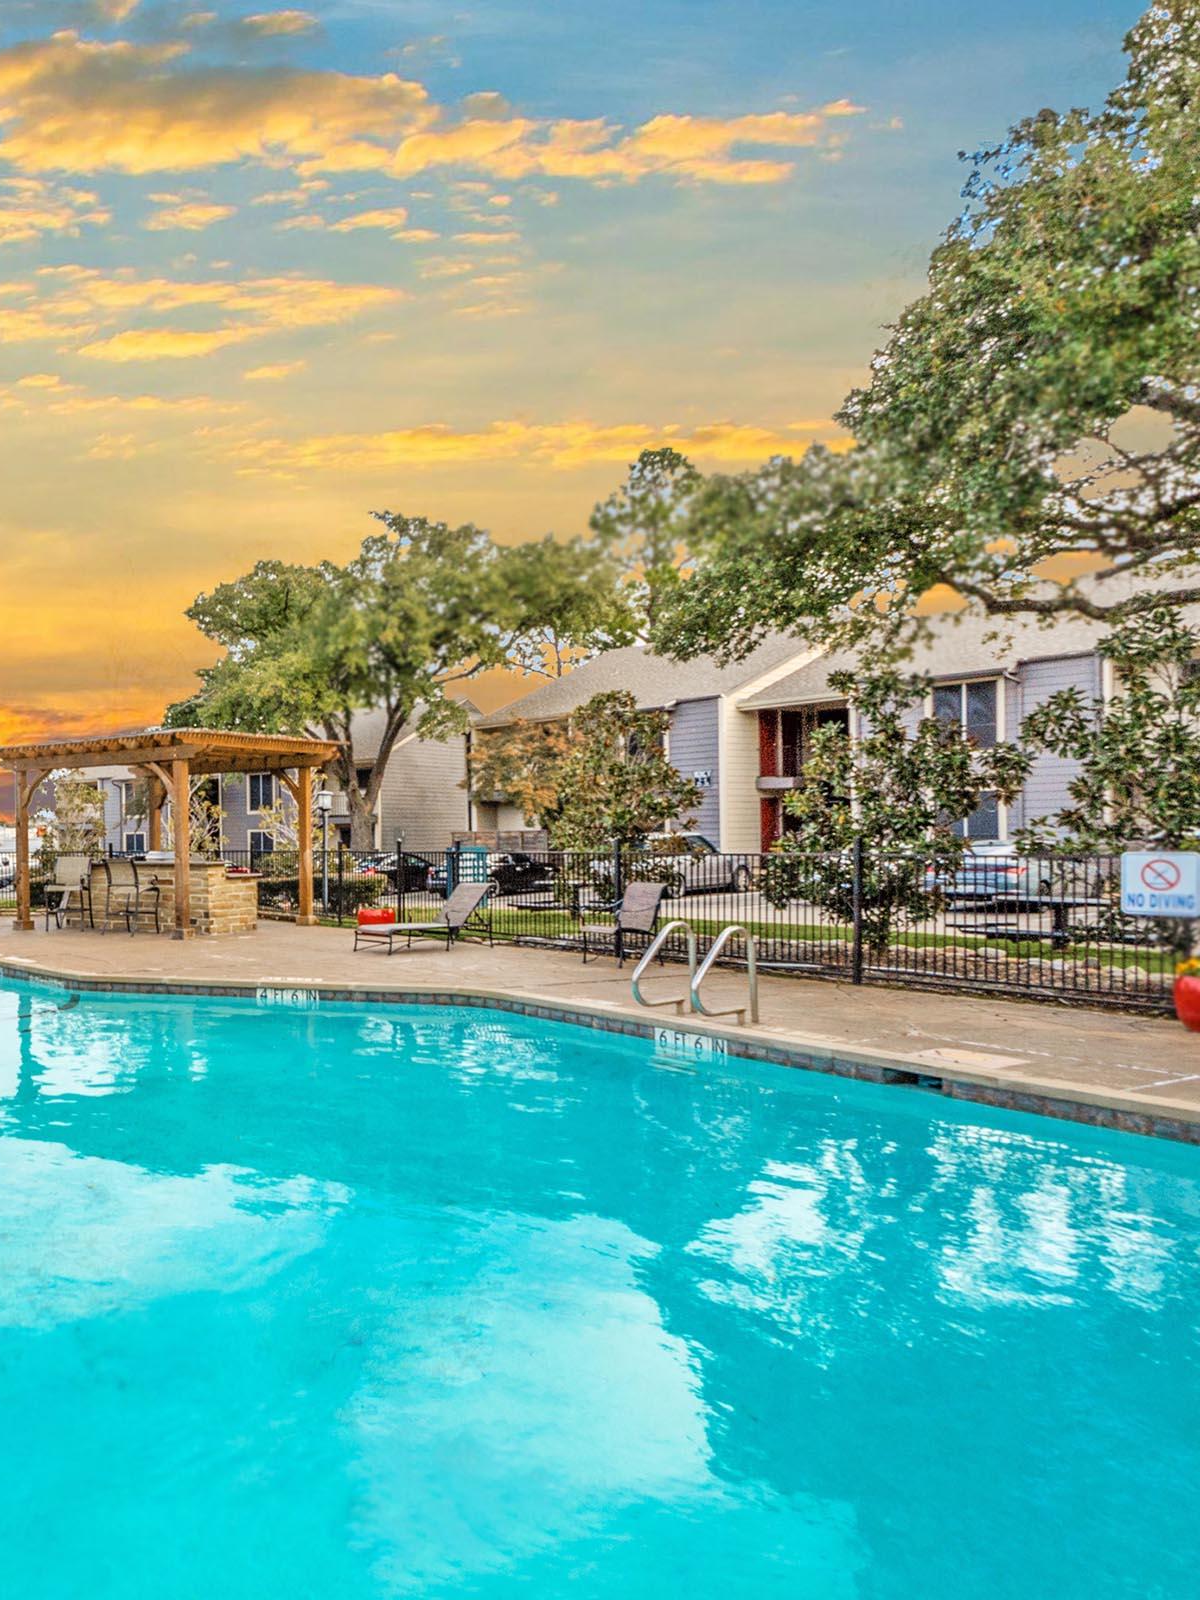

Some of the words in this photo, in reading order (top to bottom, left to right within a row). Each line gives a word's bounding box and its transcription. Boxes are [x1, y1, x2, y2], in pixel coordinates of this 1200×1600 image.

[1127, 893, 1145, 908] NO
[1149, 893, 1195, 909] DIVING
[290, 989, 299, 1001] 6
[659, 1030, 668, 1048] 6
[674, 1032, 687, 1050] FT
[695, 1037, 704, 1053] 6
[712, 1039, 725, 1054] IN
